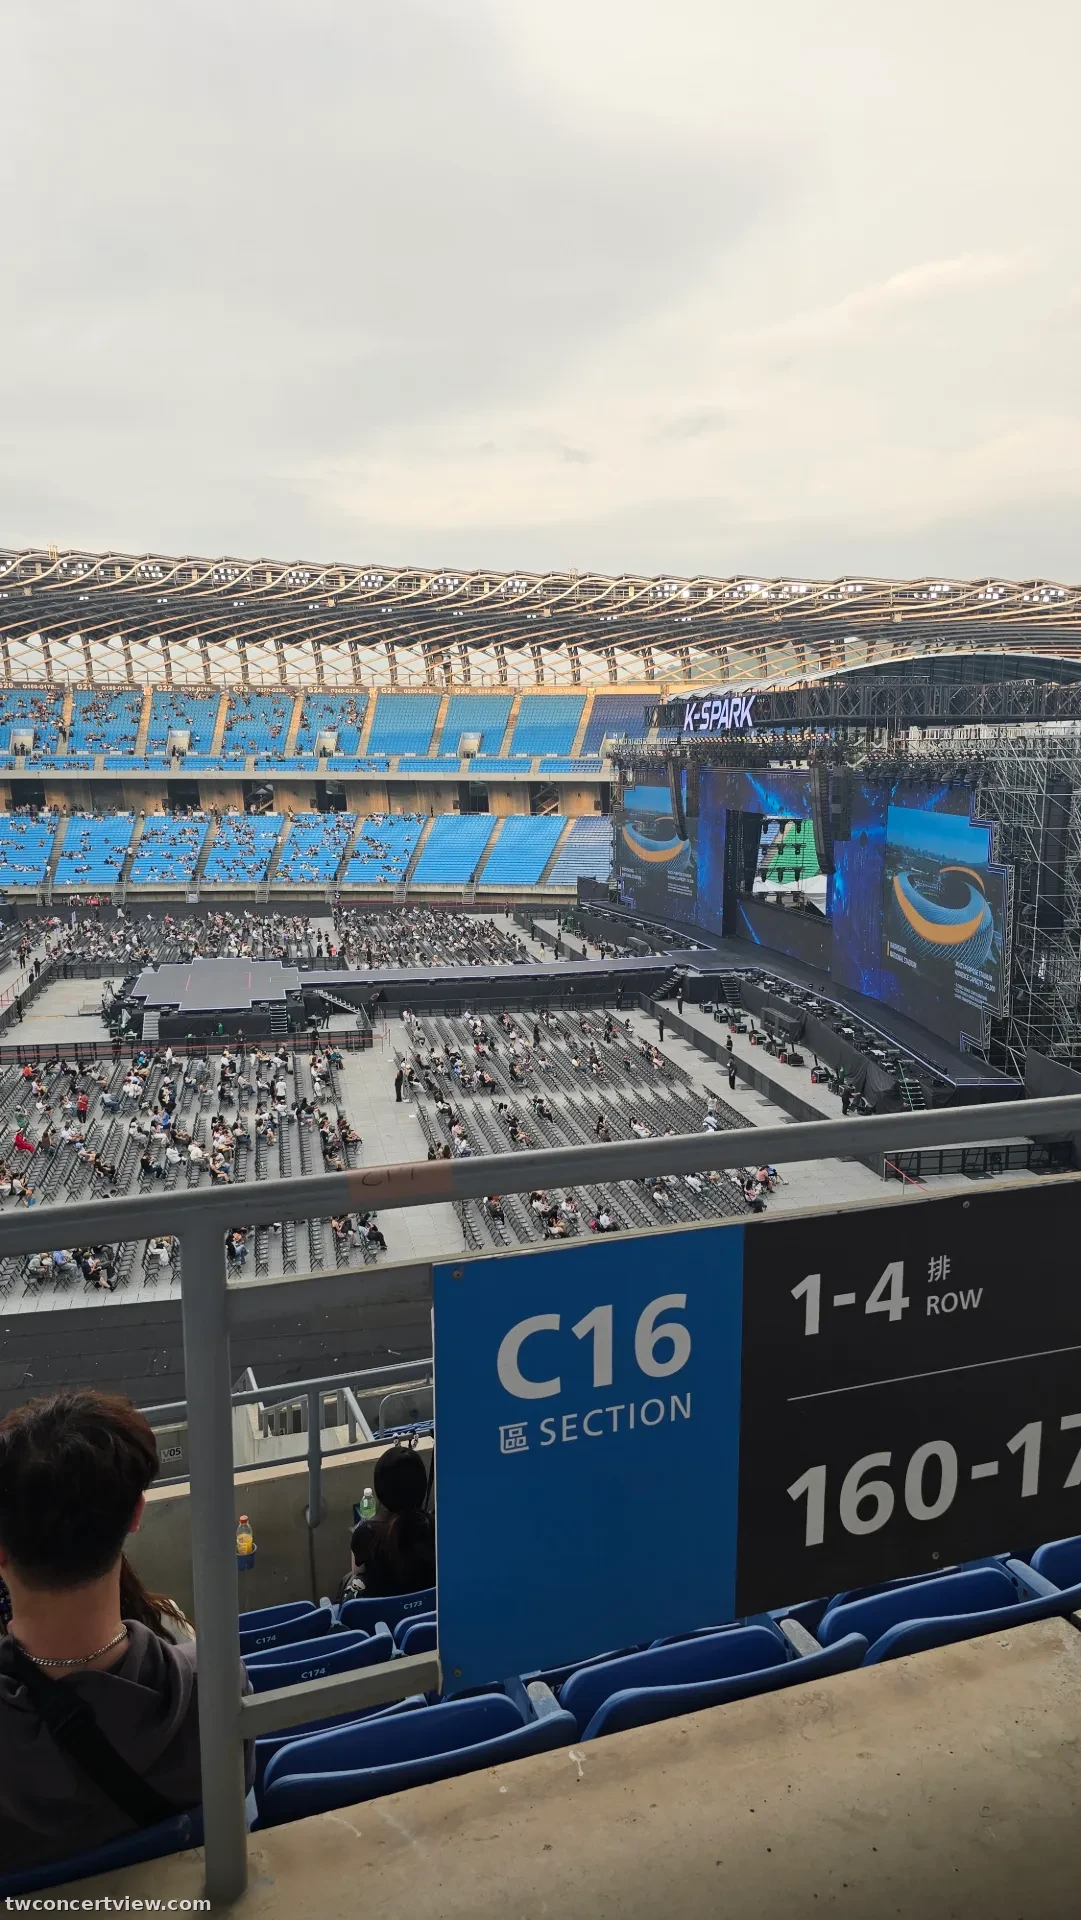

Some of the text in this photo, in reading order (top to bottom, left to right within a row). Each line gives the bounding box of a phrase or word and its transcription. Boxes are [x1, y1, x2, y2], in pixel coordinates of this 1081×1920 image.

[683, 694, 756, 731] K-SPARK
[927, 1254, 951, 1283] 排
[790, 1260, 910, 1336] 1-4
[926, 1287, 984, 1316] ROW
[496, 1293, 692, 1400] C16
[498, 1392, 692, 1454] 區 SECTION
[162, 1447, 182, 1459] V05
[403, 1600, 423, 1610] C173
[255, 1634, 277, 1645] C174
[301, 1667, 326, 1679] C174
